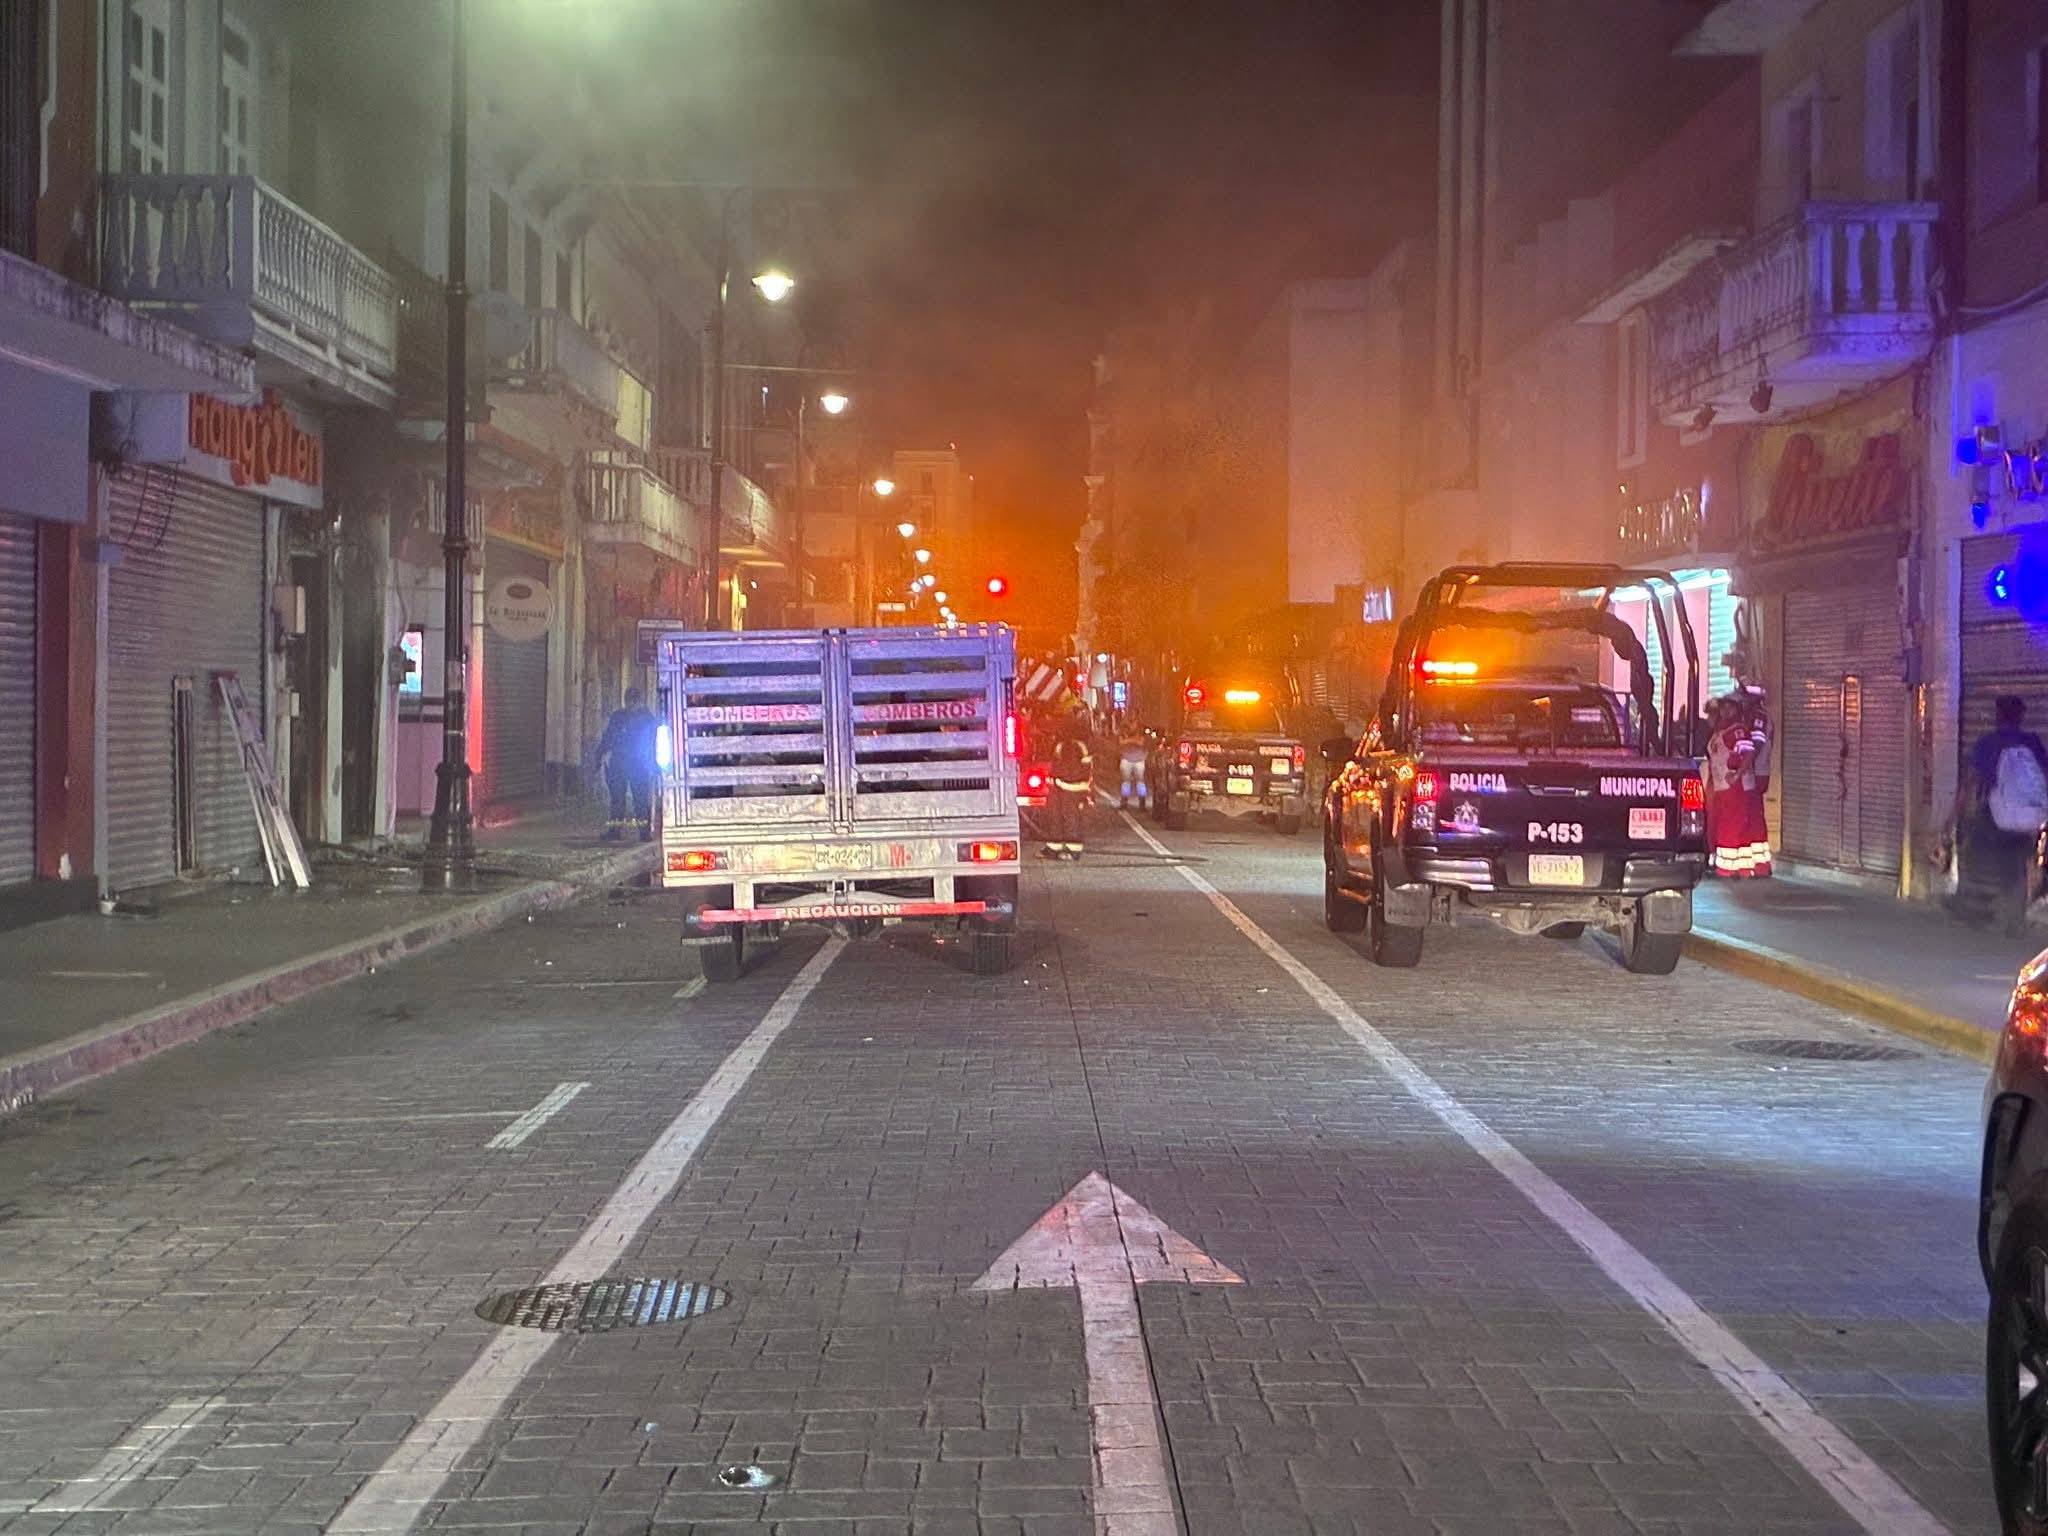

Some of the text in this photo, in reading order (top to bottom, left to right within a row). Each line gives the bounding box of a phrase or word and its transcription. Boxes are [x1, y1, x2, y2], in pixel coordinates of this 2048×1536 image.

[1449, 773, 1676, 797] POLICIA MUNICIPAL
[1528, 822, 1583, 843] P-153
